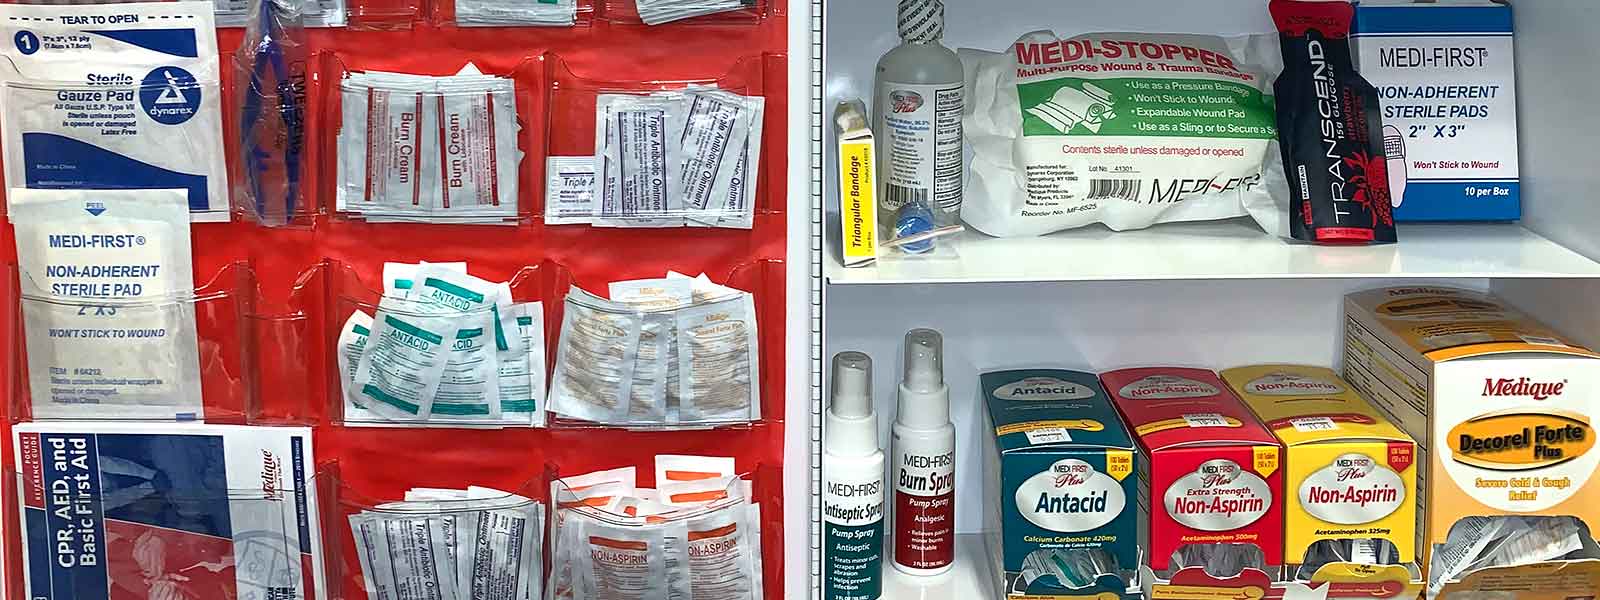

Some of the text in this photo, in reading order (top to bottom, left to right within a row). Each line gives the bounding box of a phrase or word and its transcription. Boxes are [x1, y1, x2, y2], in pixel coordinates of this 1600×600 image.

[60, 15, 139, 25] TEAR TO OPEN
[20, 34, 31, 50] 1
[1016, 40, 1240, 72] MEDI-STOPPER
[1017, 62, 1254, 81] Multi-Purpose Wound & Trauma Bandage
[87, 73, 134, 86] Sterile
[1132, 81, 1150, 90] Use
[1172, 82, 1214, 90] Pressure
[57, 90, 134, 102] Gauze Pad
[1134, 94, 1233, 104] Won't Stick to Wound
[1376, 86, 1499, 99] NON-ADHERENT
[108, 104, 124, 112] Type
[1327, 64, 1345, 140] 15g GLUCOSE
[114, 112, 136, 120] pouch
[150, 107, 193, 116] dynarex
[1137, 108, 1246, 118] Expandable Wound Pad
[1384, 105, 1488, 118] STERILE PADS
[69, 120, 94, 128] opened
[104, 120, 136, 129] damaged
[1138, 122, 1158, 131] Use
[1180, 122, 1204, 134] Sling
[1205, 125, 1214, 134] or
[1216, 124, 1226, 134] to
[1228, 124, 1259, 134] Secure
[1308, 40, 1350, 224] TRANSCEND
[1409, 125, 1465, 138] 2" X 3"
[400, 112, 414, 183] Burn Cream
[448, 113, 462, 188] Burn Cream
[649, 114, 662, 176] Triple Antibiotic
[706, 132, 724, 170] Antibiotic
[1062, 144, 1244, 158] Contents sterile unless damaged or opened
[1414, 160, 1499, 169] Won't Stick to Wound
[564, 177, 587, 189] Triple
[694, 170, 712, 207] Ointment
[1300, 165, 1309, 199] MAINTAIN
[1465, 186, 1510, 197] 10 per Box
[850, 156, 862, 248] Triangular Bandage
[46, 265, 160, 278] NON-ADHERENT
[52, 284, 142, 296] STERILE PAD
[432, 289, 471, 311] ANTACID
[49, 328, 165, 338] WON'T STICK TO WOUND
[391, 331, 430, 351] ANTACID
[1012, 386, 1076, 396] Antacid
[1131, 385, 1214, 397] Non-Aspirin
[1255, 382, 1338, 392] Non-Aspirin
[1460, 424, 1584, 452] Decorel Forte
[1534, 445, 1562, 460] Plus
[1054, 465, 1088, 473] MEDI FIRST
[1202, 466, 1218, 474] MEDI
[1336, 468, 1366, 482] Plus
[900, 468, 926, 491] Burn
[1055, 473, 1084, 488] Plus
[1202, 474, 1232, 488] Plus
[1476, 477, 1571, 489] Severe Cold & Cough
[1187, 487, 1251, 497] Extra Strength
[1308, 484, 1397, 508] Non-Aspirin
[1508, 490, 1538, 501] Relief
[48, 438, 76, 568] CPR, AED, and
[69, 438, 97, 566] Basic First Aid
[910, 498, 949, 508] Pump Spray
[1035, 491, 1108, 514] Antacid
[1174, 494, 1264, 518] Non-Aspirin
[824, 500, 864, 524] Antiseptic
[914, 514, 945, 524] Analgesic
[478, 510, 492, 546] Ointment
[832, 528, 874, 540] Pump Spray
[1236, 534, 1258, 542] 500mg
[415, 524, 432, 579] Triple Antibiotic
[688, 538, 736, 556] ON-ASPIRIN
[836, 543, 870, 552] Antiseptic
[592, 550, 648, 565] NON-ASPIRIN
[834, 577, 850, 585] Helps
